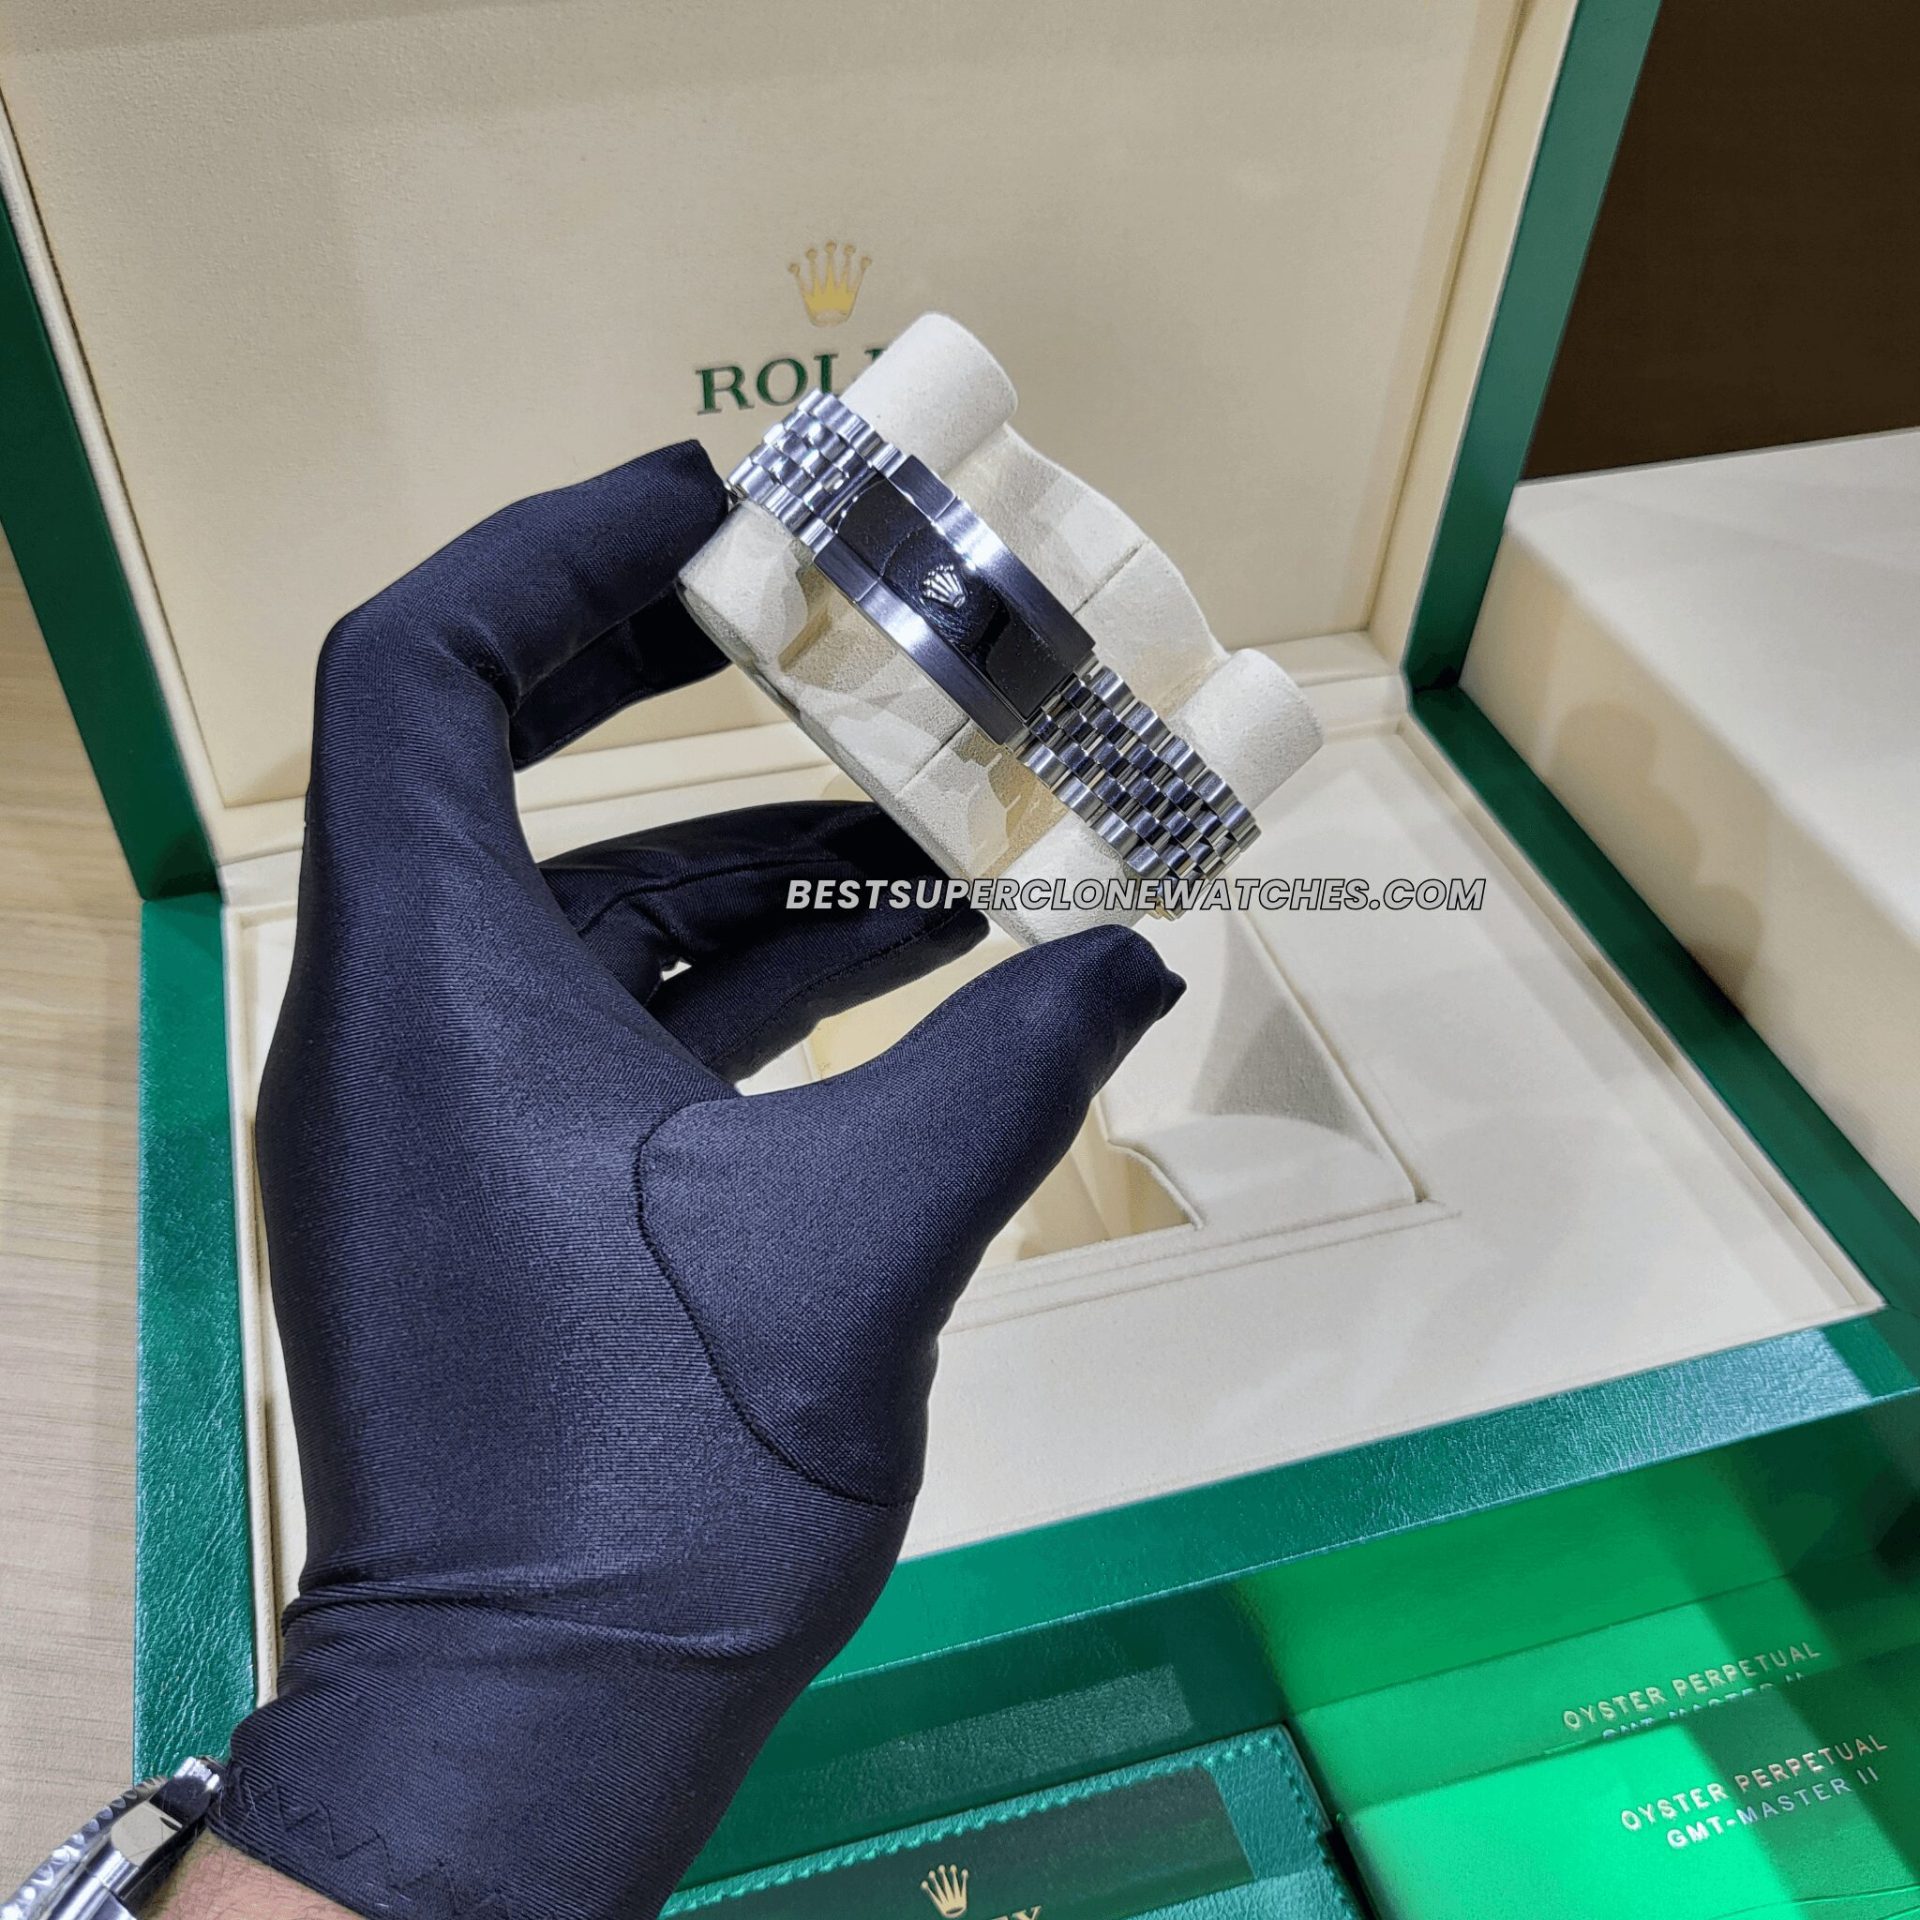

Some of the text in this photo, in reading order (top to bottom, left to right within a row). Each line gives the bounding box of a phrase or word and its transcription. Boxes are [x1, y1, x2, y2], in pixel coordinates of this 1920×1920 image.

[695, 347, 888, 416] ROL
[1563, 1686, 1668, 1731] OYSTER
[1672, 1642, 1821, 1700] PERPETUAL
[1621, 1734, 1888, 1832] OYSTER PERPETUAL
[1666, 1766, 1879, 1850] GMT-MASTER II
